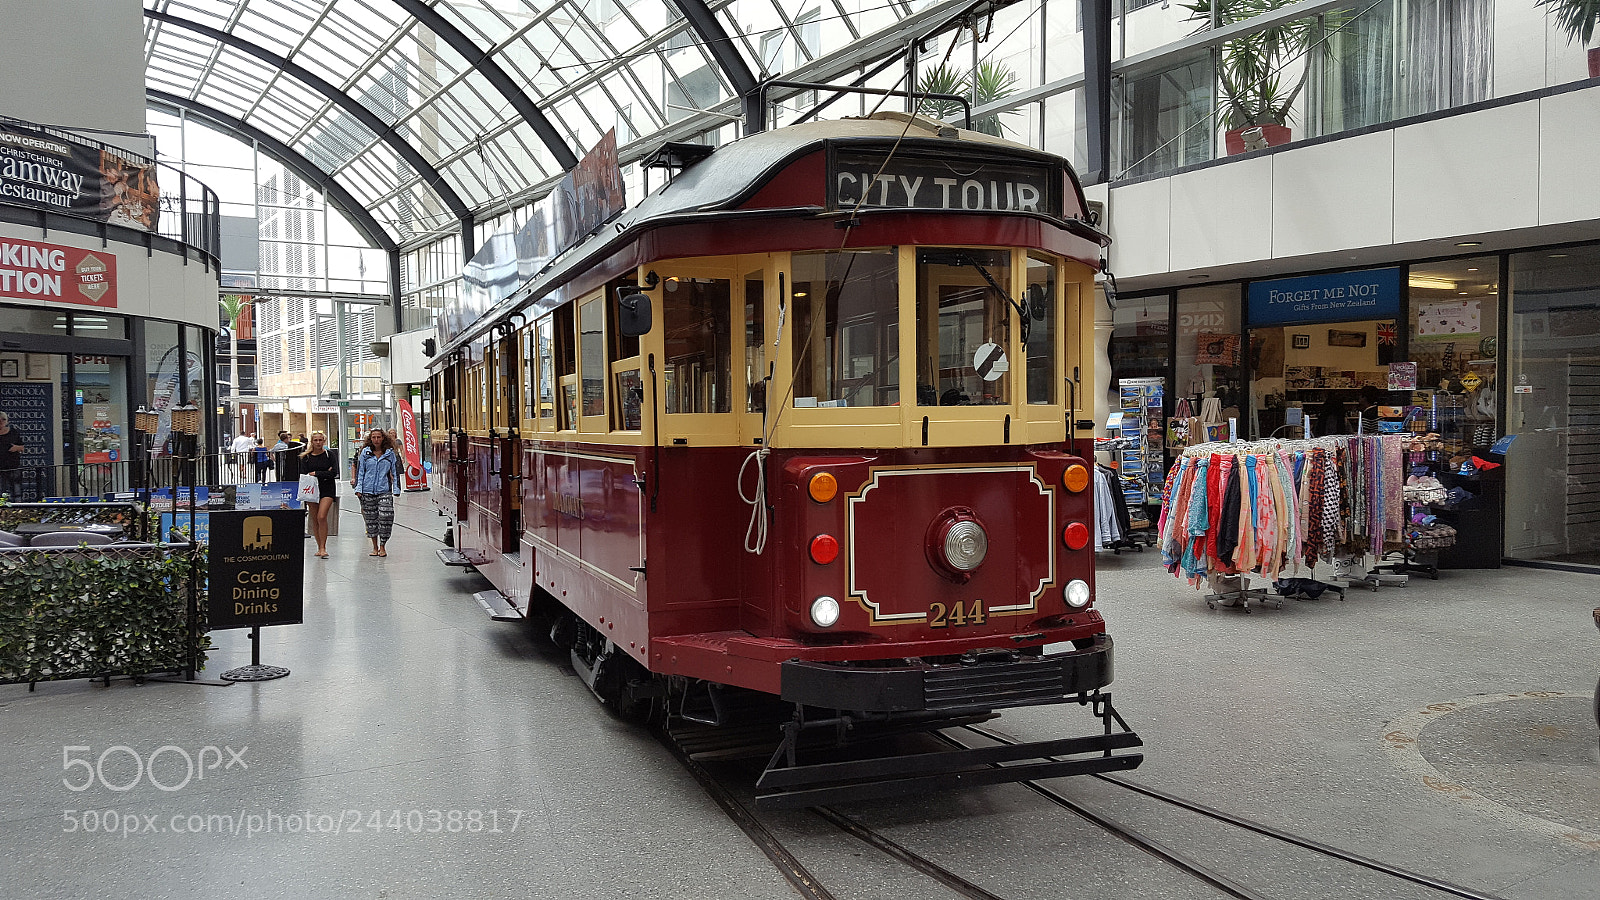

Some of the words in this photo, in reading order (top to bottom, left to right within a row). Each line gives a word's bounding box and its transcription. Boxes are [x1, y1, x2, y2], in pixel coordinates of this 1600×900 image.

[0, 133, 21, 144] NOW
[22, 138, 67, 153] OPERATING
[0, 147, 63, 167] CHRISTCHURCH
[0, 155, 83, 199] amway
[837, 171, 924, 207] CITY
[934, 177, 1040, 213] TOUR
[0, 243, 66, 271] KING
[0, 269, 61, 296] TION
[80, 274, 104, 283] TICKETS
[1269, 289, 1320, 304] FORGET
[1323, 287, 1345, 299] ME
[1348, 284, 1379, 297] NOT
[1294, 303, 1310, 311] Gifts
[1311, 302, 1329, 310] From
[1330, 301, 1346, 309] New
[1347, 298, 1376, 307] Zealand
[1, 387, 45, 395] GONDOLA
[1, 399, 45, 407] GONDOLA
[7, 411, 46, 419] ONDOLA
[237, 554, 290, 562] COSMOPOLITAN
[237, 570, 276, 584] Cafe
[233, 587, 279, 600] Dining
[235, 602, 278, 615] Drinks
[930, 600, 985, 627] 244
